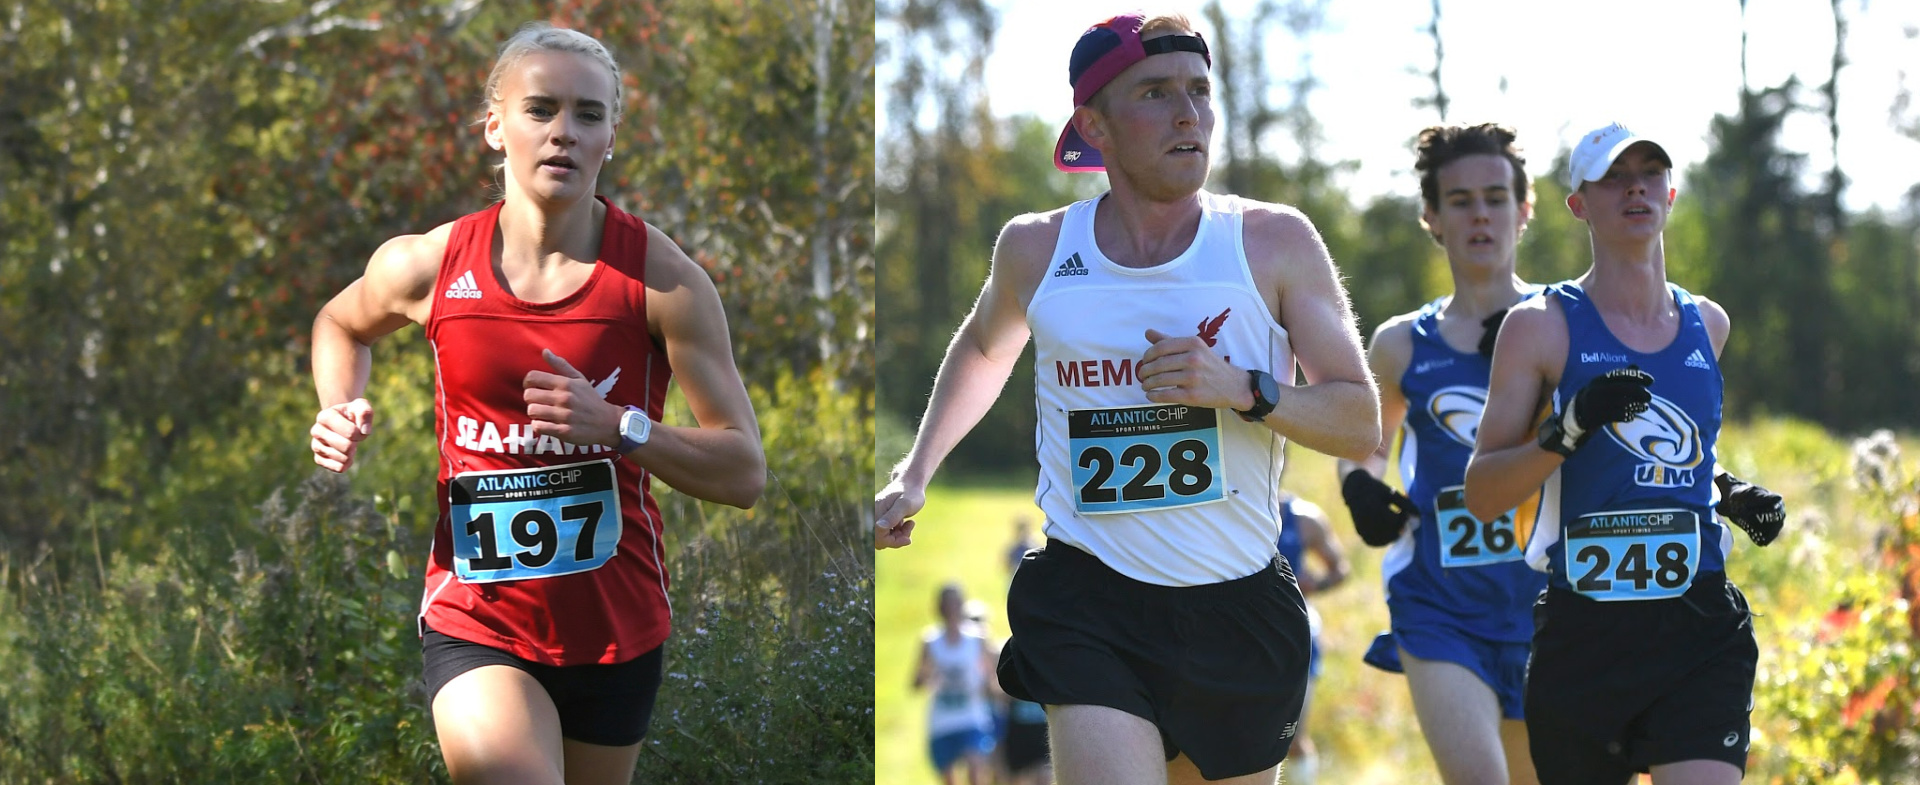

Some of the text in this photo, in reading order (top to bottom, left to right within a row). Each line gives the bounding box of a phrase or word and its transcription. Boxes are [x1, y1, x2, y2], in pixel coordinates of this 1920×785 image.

[1054, 267, 1089, 277] adidas
[445, 288, 483, 299] adidas
[1137, 424, 1161, 432] TIMING
[1077, 438, 1213, 504] 228
[505, 491, 527, 499] SPORT
[466, 500, 605, 572] 197
[1448, 515, 1516, 558] 26
[1575, 543, 1690, 592] 248
